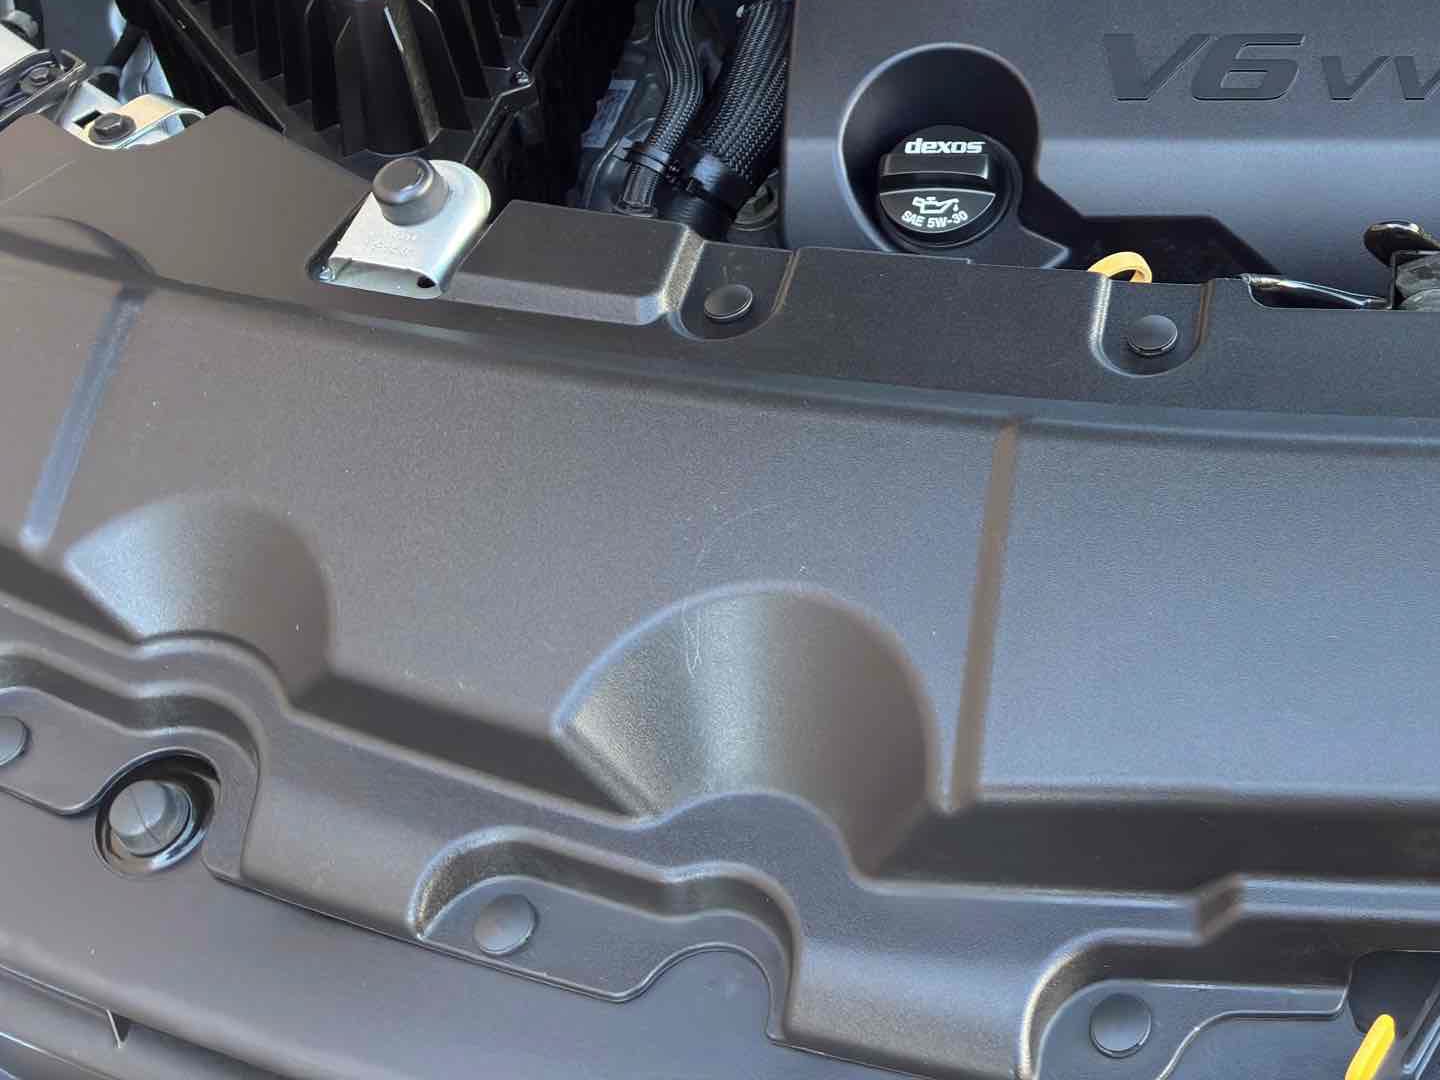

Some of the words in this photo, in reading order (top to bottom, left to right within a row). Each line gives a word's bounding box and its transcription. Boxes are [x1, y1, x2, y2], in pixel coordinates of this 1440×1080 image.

[1103, 33, 1306, 102] V6
[904, 138, 986, 154] dexos
[901, 210, 922, 228] SAE
[926, 211, 968, 228] 5W-30
